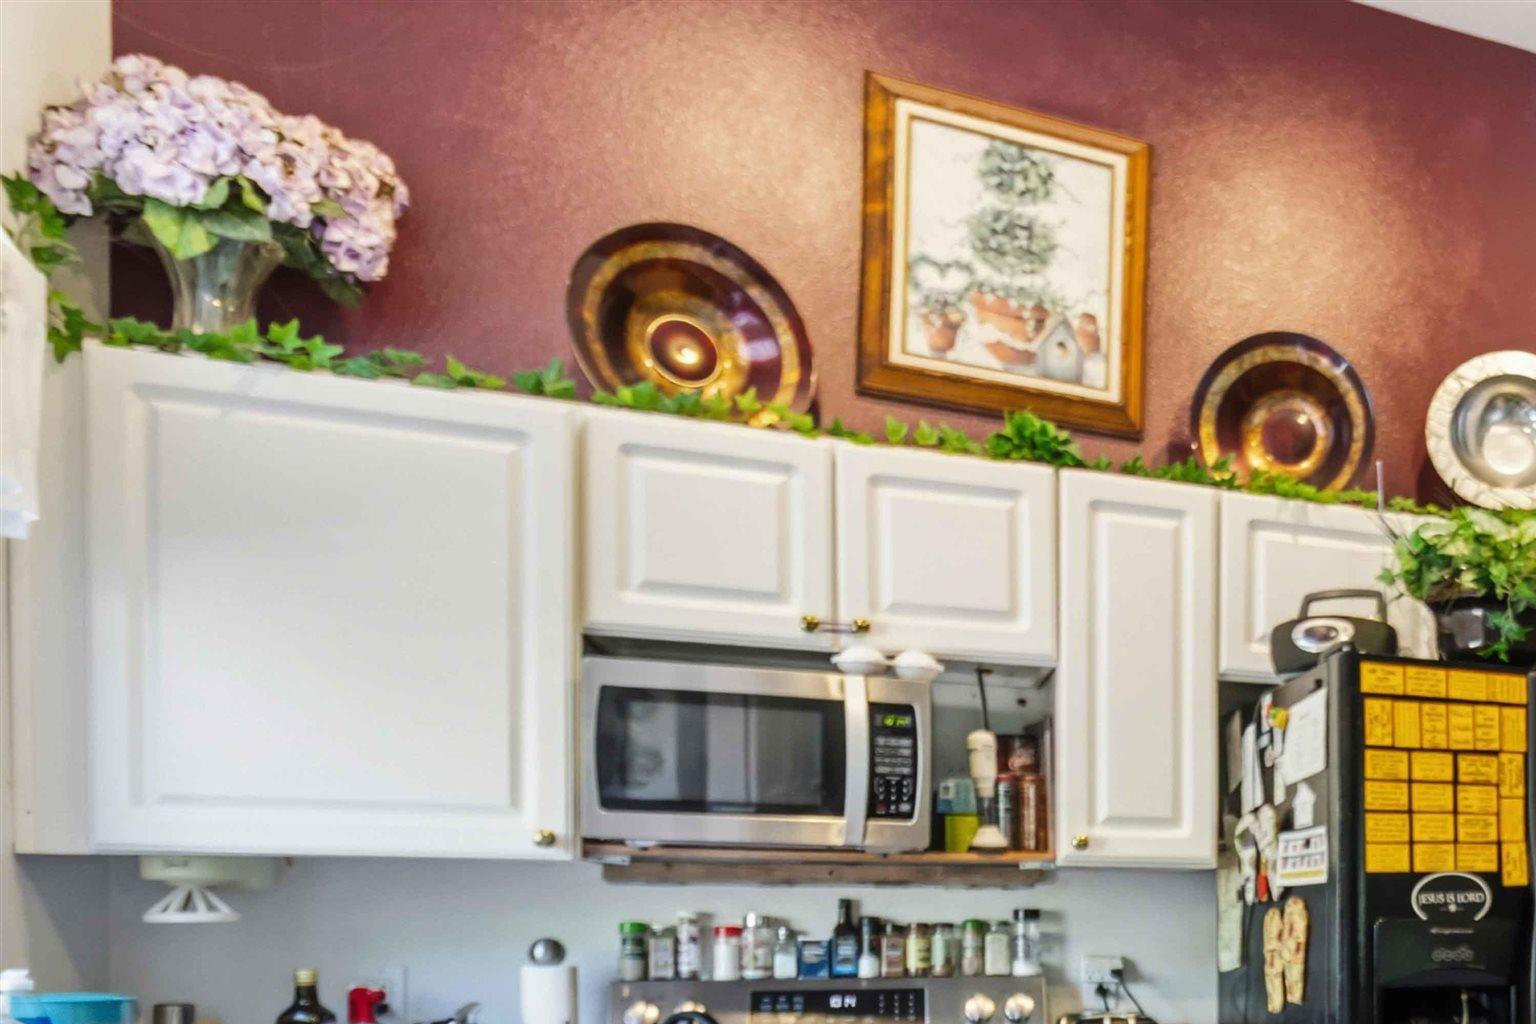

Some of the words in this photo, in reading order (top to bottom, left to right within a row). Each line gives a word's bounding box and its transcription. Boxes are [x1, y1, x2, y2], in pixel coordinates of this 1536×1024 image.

[1418, 891, 1444, 906] JESUS
[1446, 891, 1456, 904] IS
[1457, 890, 1486, 904] LORD
